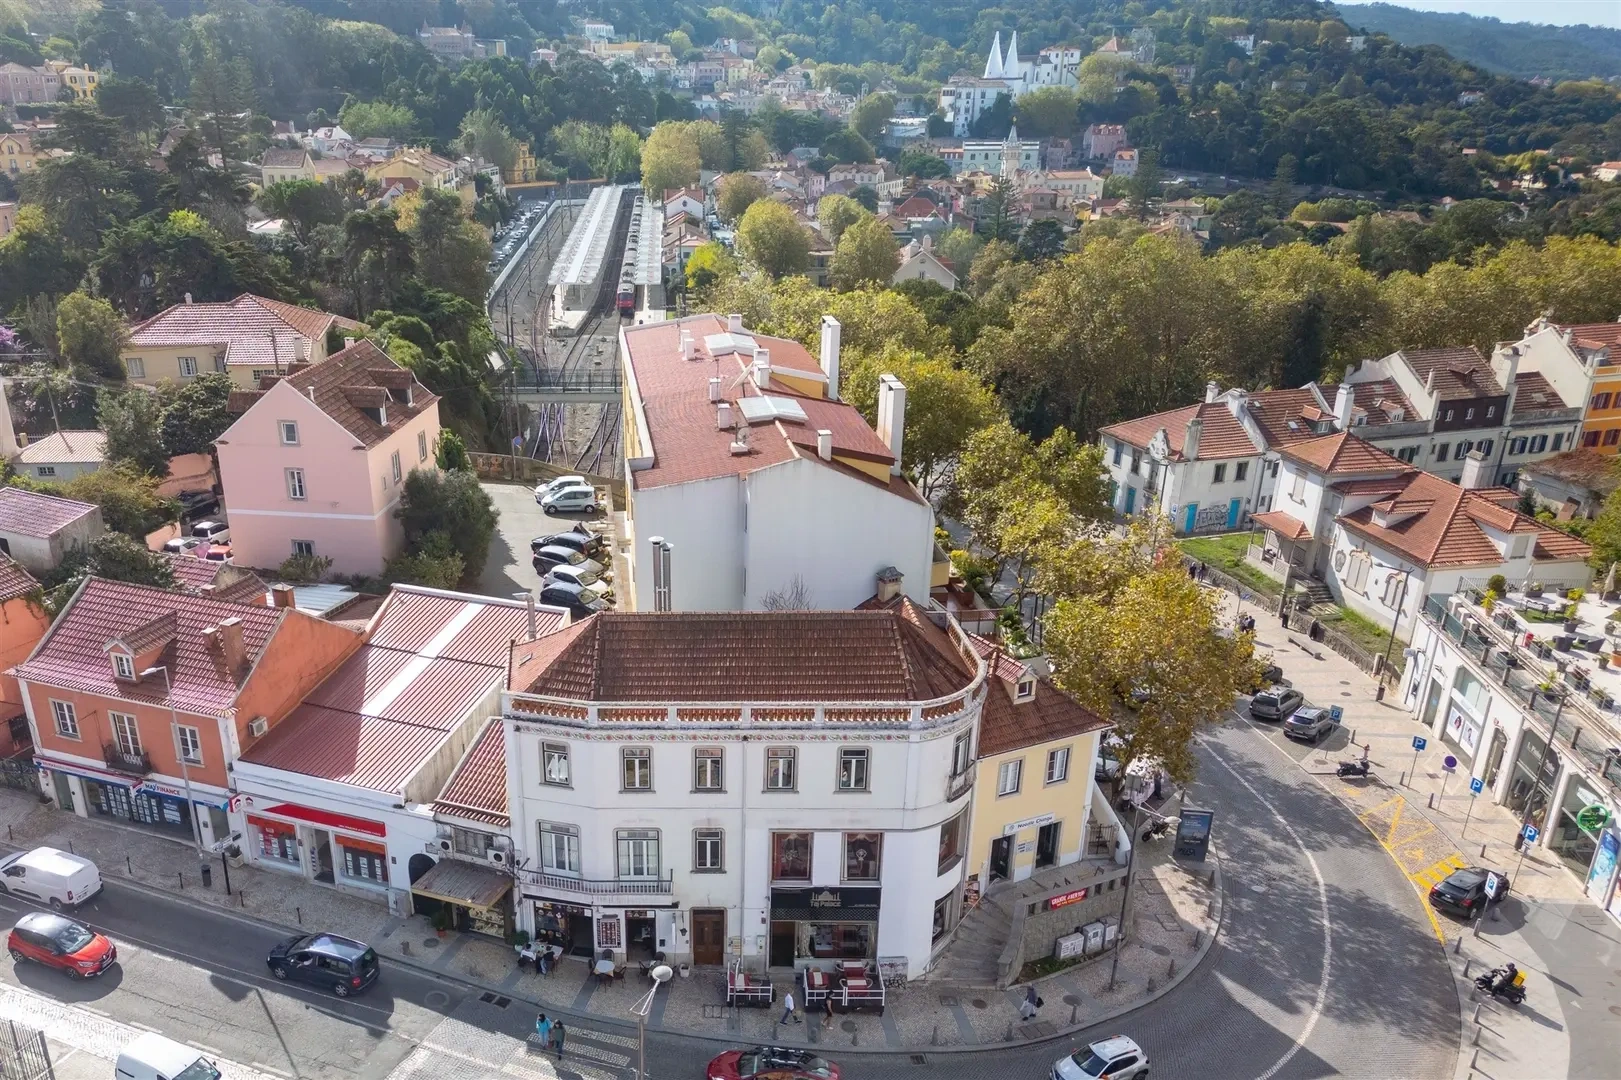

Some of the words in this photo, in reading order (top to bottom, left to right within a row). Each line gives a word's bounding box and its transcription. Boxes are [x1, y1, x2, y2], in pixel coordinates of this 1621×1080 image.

[1415, 738, 1423, 747] P
[1472, 780, 1481, 789] P
[1525, 827, 1535, 838] P
